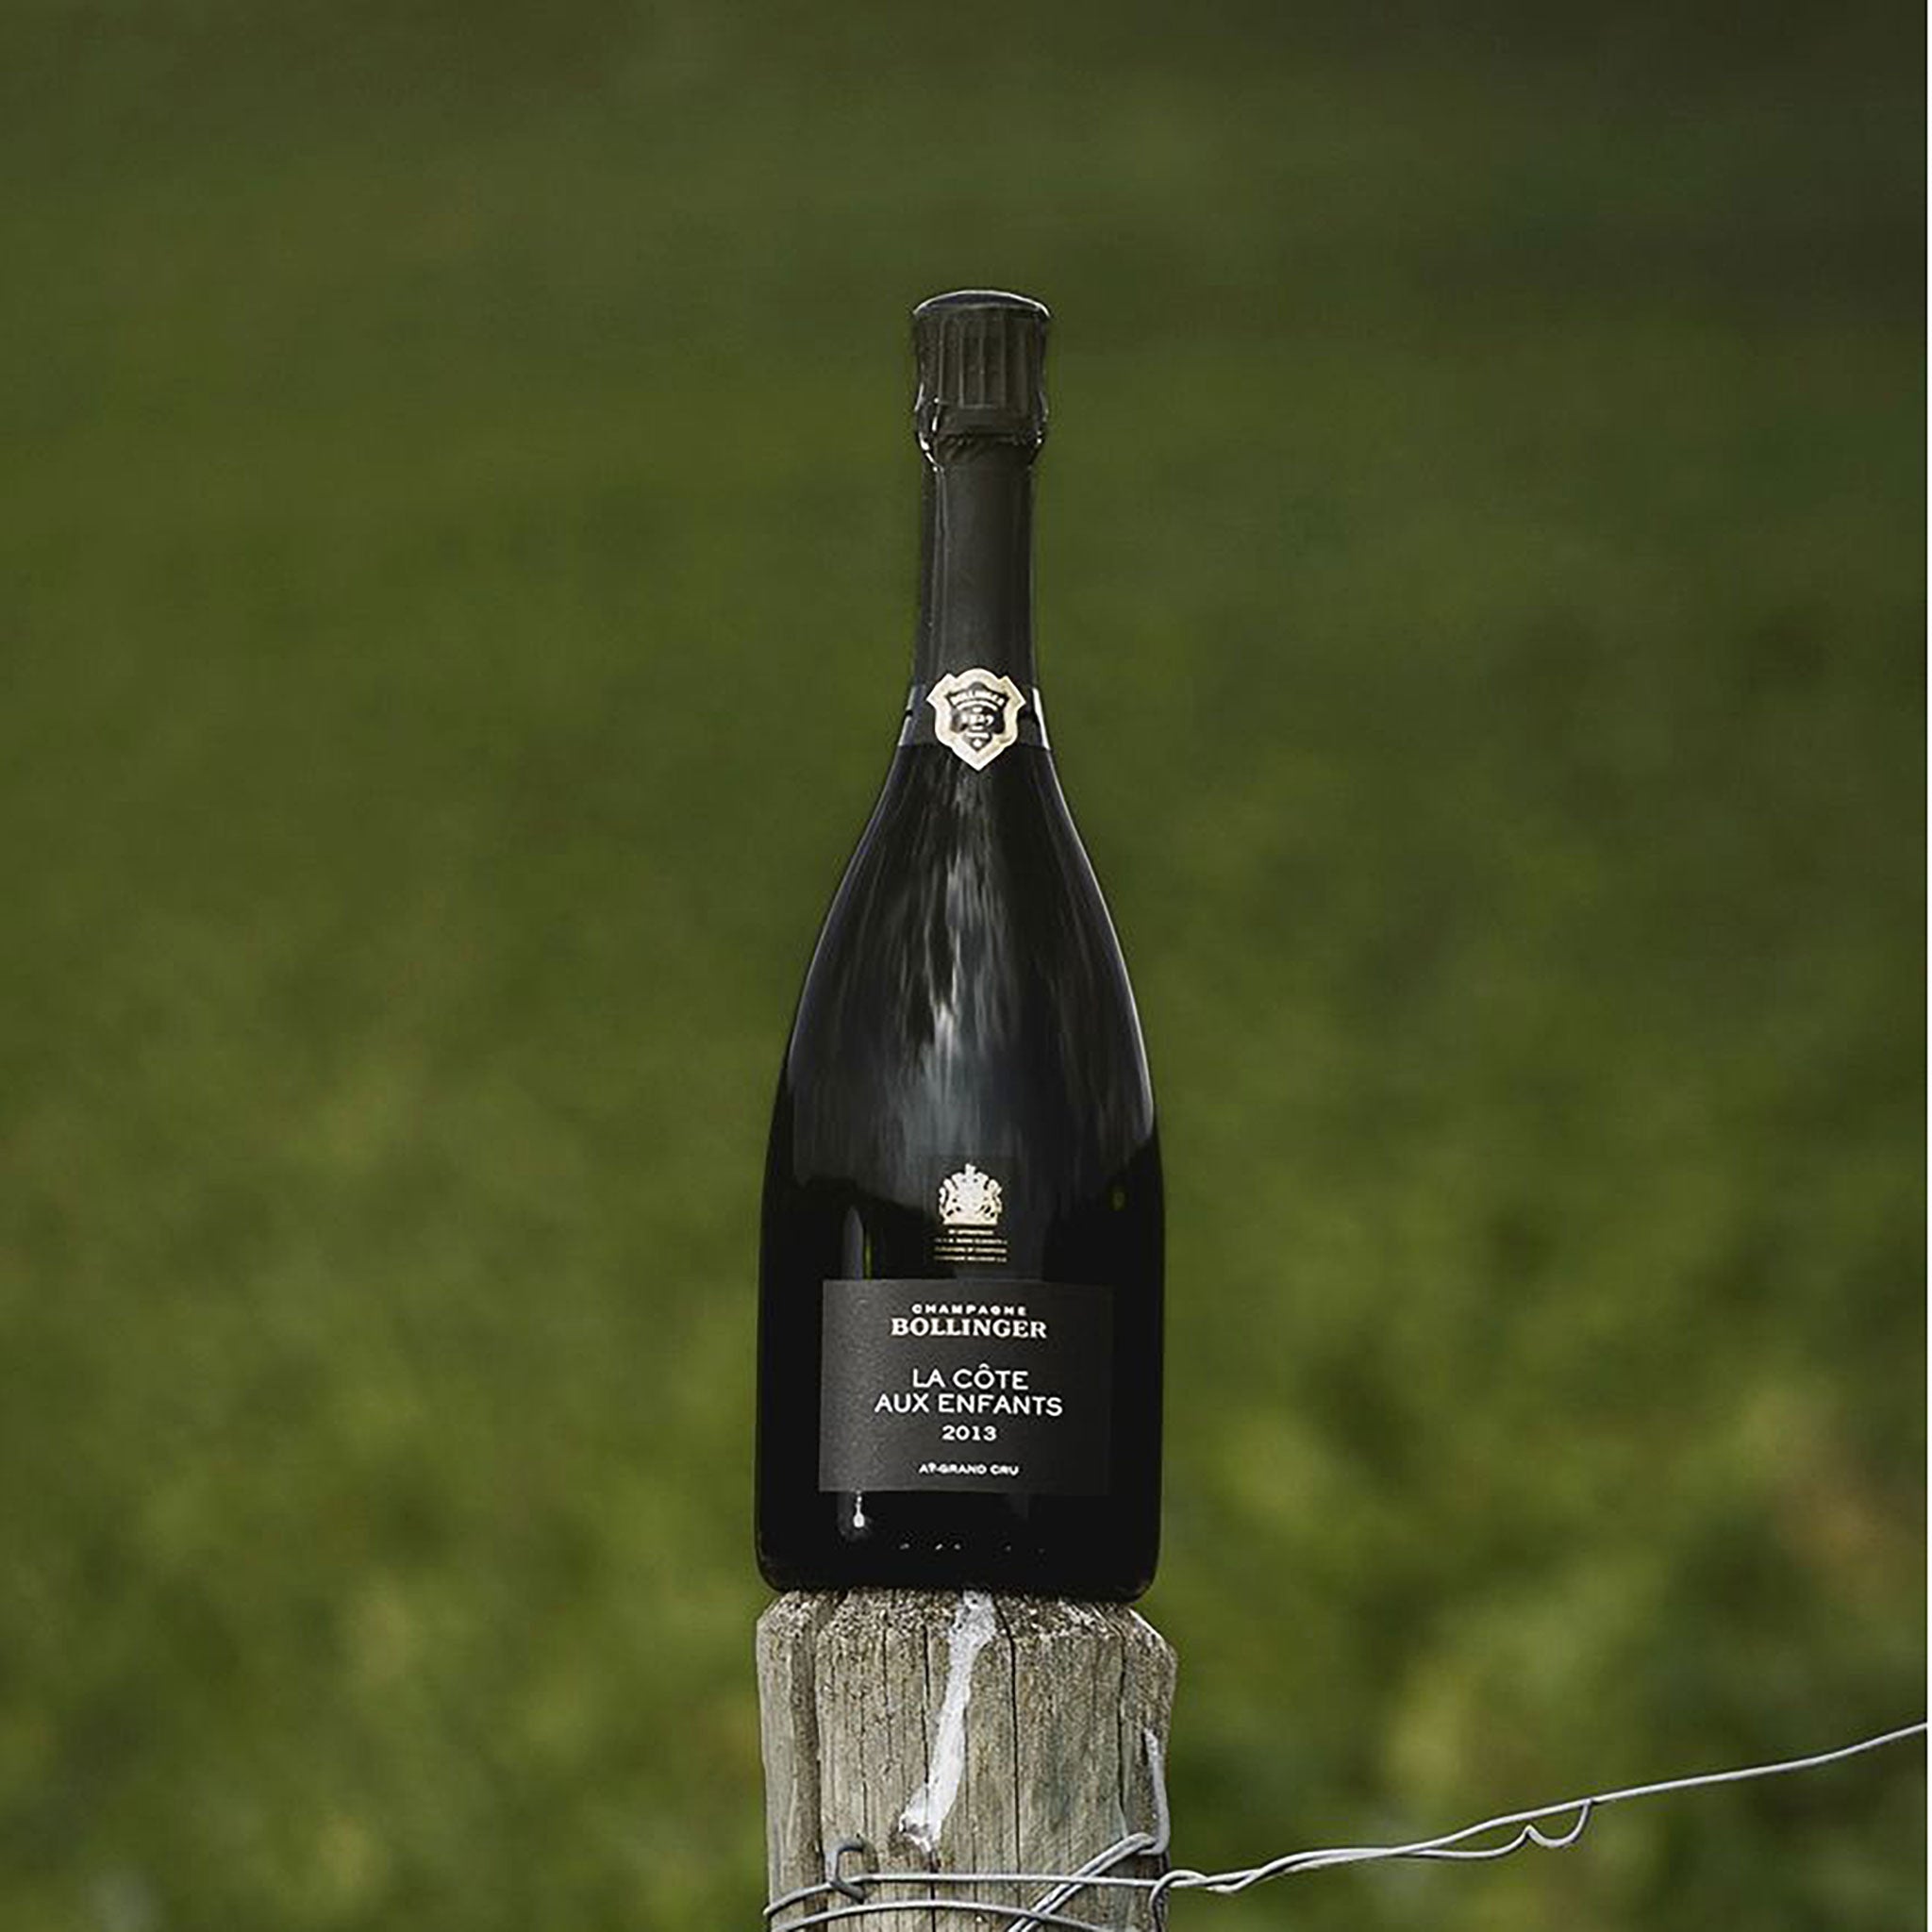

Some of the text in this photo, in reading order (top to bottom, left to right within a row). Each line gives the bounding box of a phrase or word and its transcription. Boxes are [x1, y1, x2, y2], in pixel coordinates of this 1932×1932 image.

[911, 1303, 1026, 1316] CHAMPAGNE
[890, 1317, 1047, 1339] BOLLINGER
[912, 1363, 1029, 1391] LA CÔTE
[874, 1393, 1063, 1417] AUX ENFANTS
[941, 1424, 997, 1441] 2013
[990, 1463, 1020, 1476] CRU
